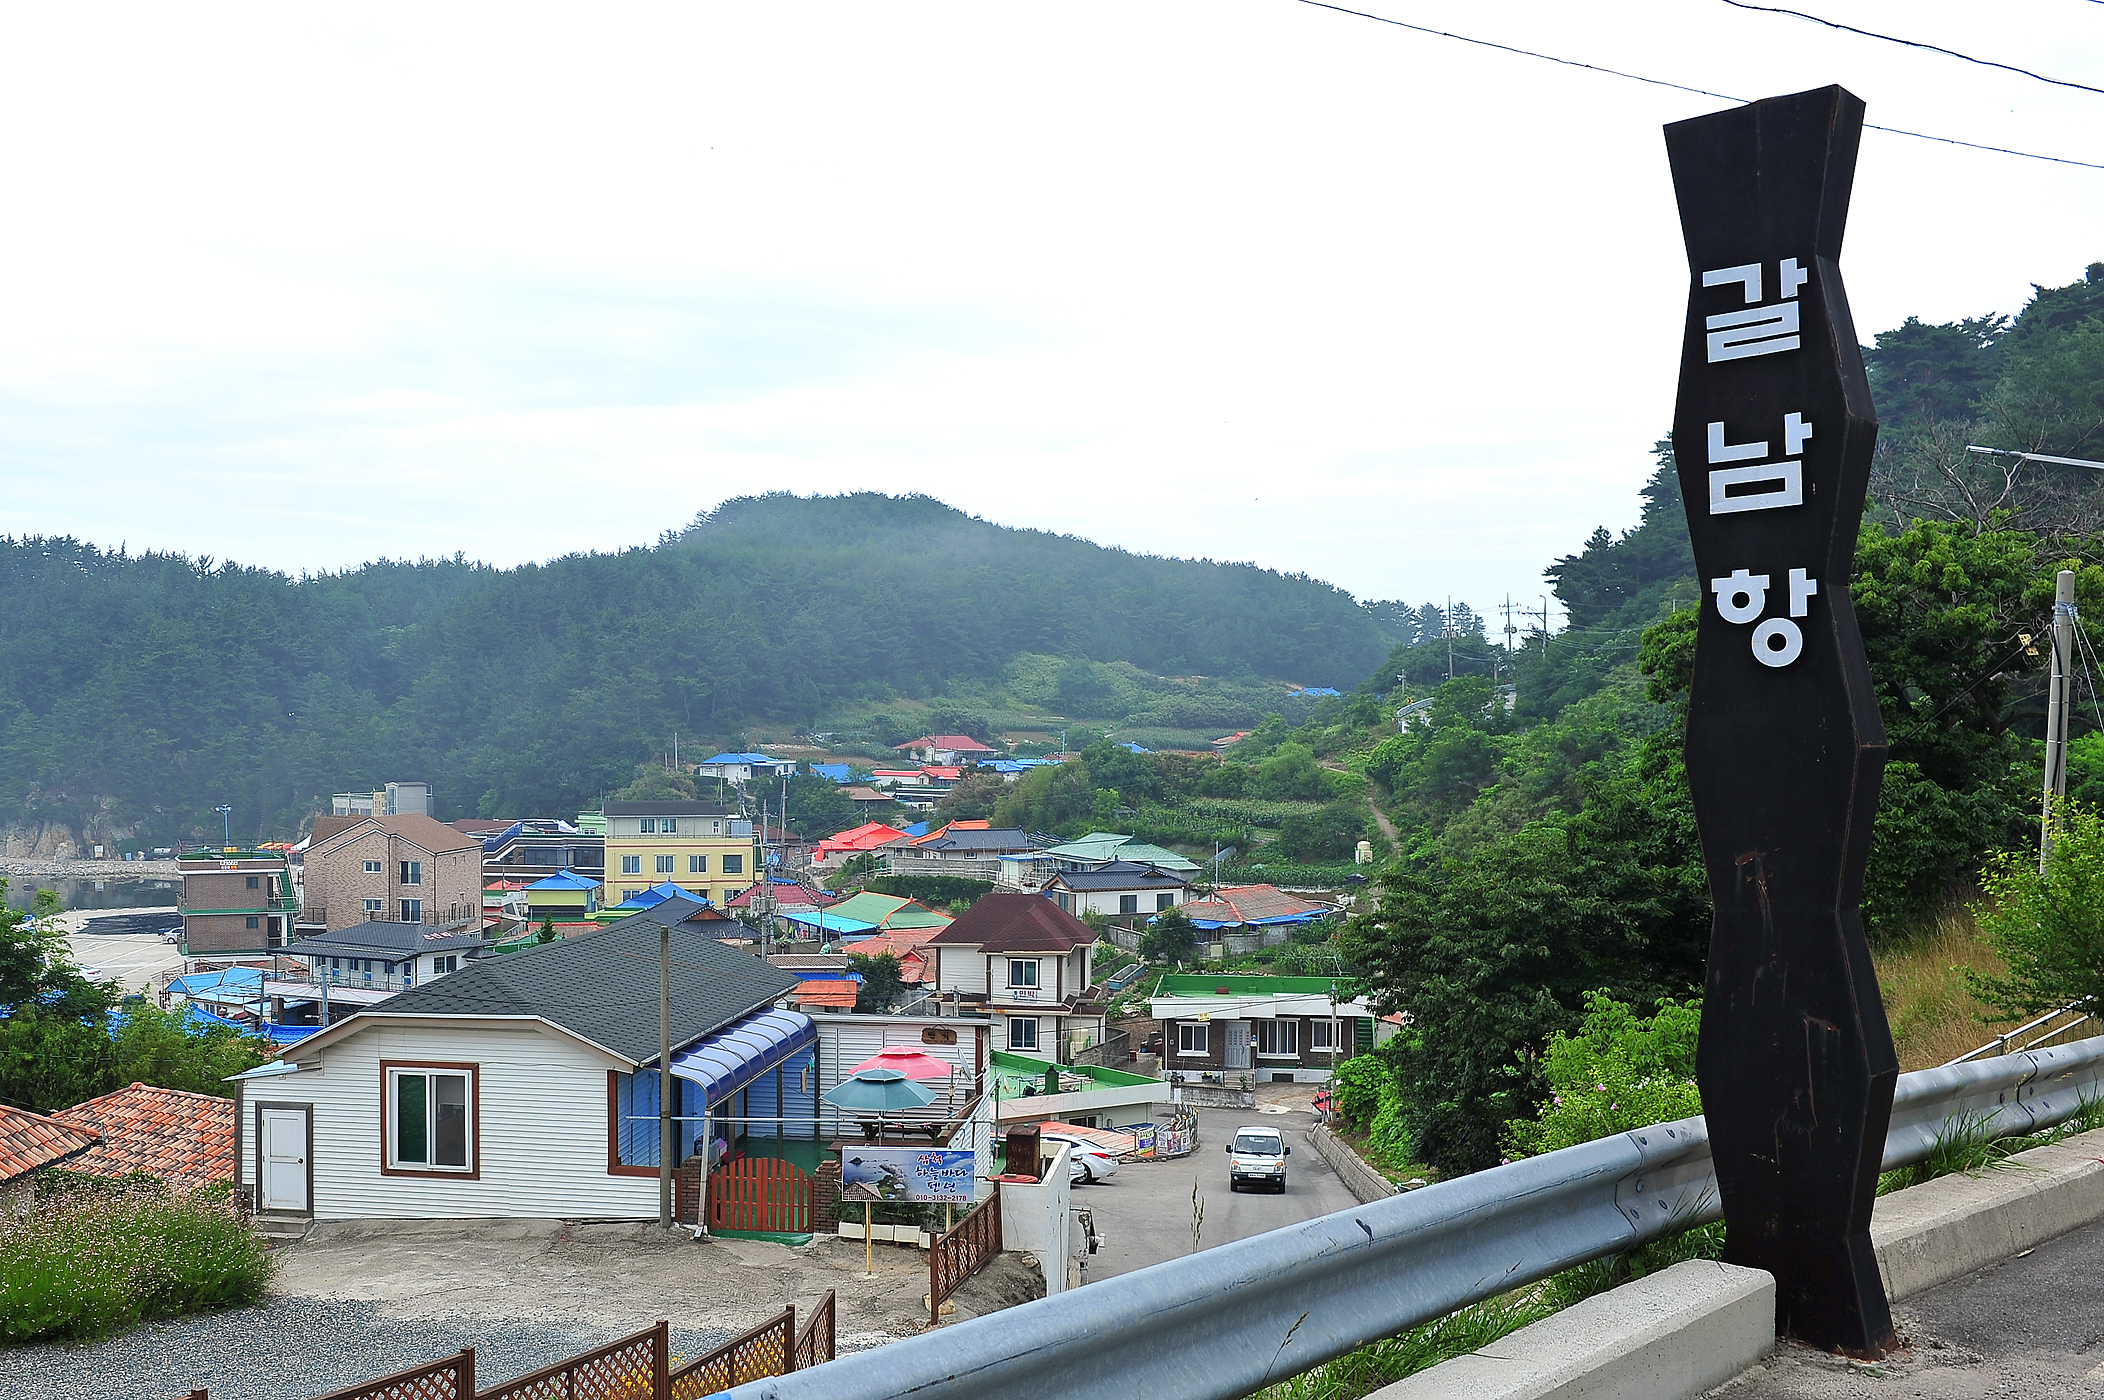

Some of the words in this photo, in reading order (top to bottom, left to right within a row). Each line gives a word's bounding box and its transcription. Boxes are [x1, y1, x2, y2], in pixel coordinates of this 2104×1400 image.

[1702, 257, 1817, 668] 갈남항
[917, 1152, 943, 1165] 삼척
[915, 1194, 967, 1202] 010-3132-2178
